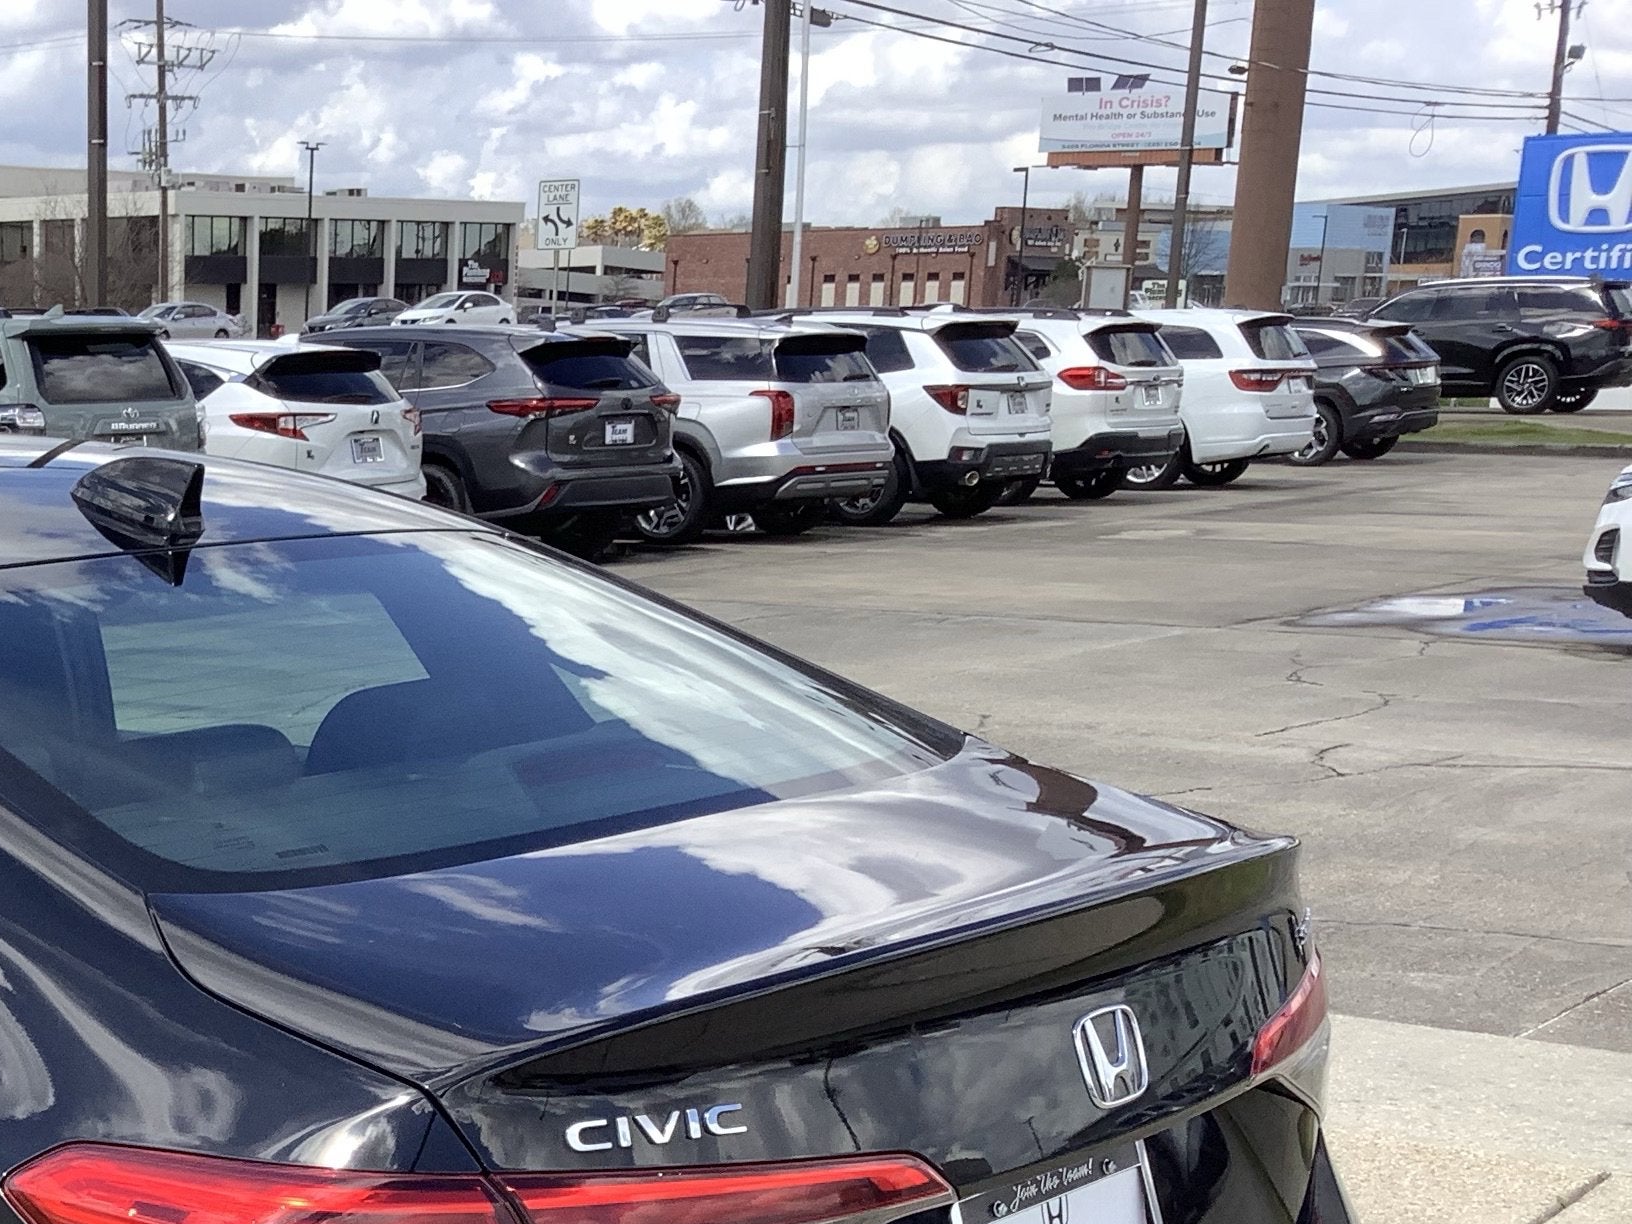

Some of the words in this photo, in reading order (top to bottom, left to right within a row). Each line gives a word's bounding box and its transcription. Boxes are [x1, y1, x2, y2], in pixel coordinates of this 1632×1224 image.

[1099, 97, 1114, 110] In
[1118, 96, 1171, 109] Crisis?
[1052, 112, 1088, 122] Mental
[1090, 111, 1124, 121] Health
[1126, 112, 1137, 120] or
[1196, 110, 1216, 119] Use
[542, 183, 576, 193] CENTER
[547, 193, 571, 203] LANE
[544, 237, 569, 246] ONLY
[945, 232, 956, 245] &
[957, 231, 983, 246] BAO
[611, 425, 628, 435] TEAM
[565, 1103, 748, 1152] CIVIC
[1010, 1181, 1038, 1213] Join
[1037, 1172, 1062, 1194] The
[1059, 1157, 1094, 1186] Team!
